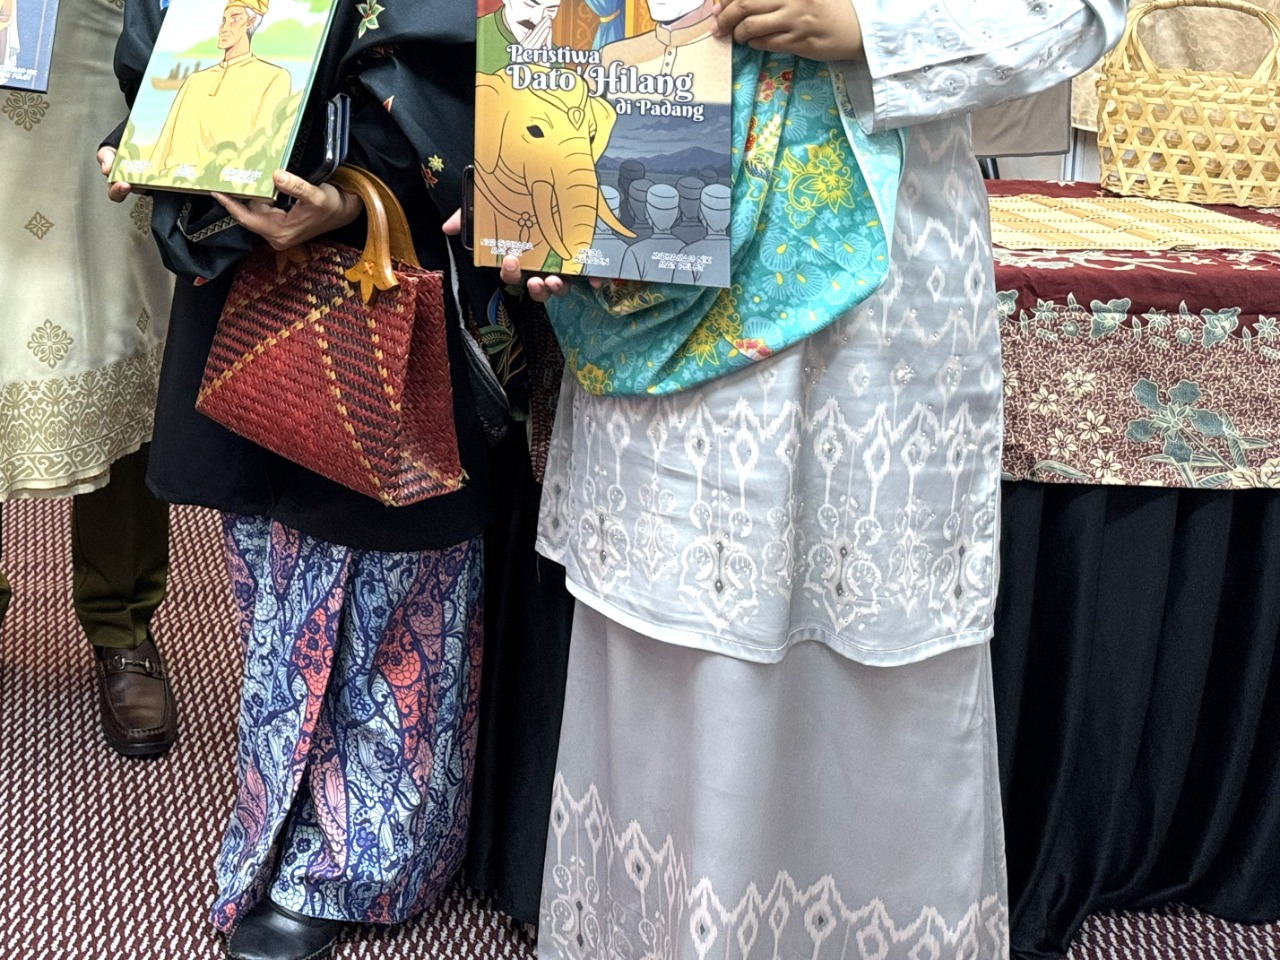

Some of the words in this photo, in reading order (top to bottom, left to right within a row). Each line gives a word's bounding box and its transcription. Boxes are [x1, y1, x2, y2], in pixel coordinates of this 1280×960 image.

[506, 44, 600, 64] Peristiwa
[506, 64, 582, 91] Dato'
[588, 60, 694, 102] Hilang
[615, 98, 632, 115] di
[635, 99, 704, 122] Padang
